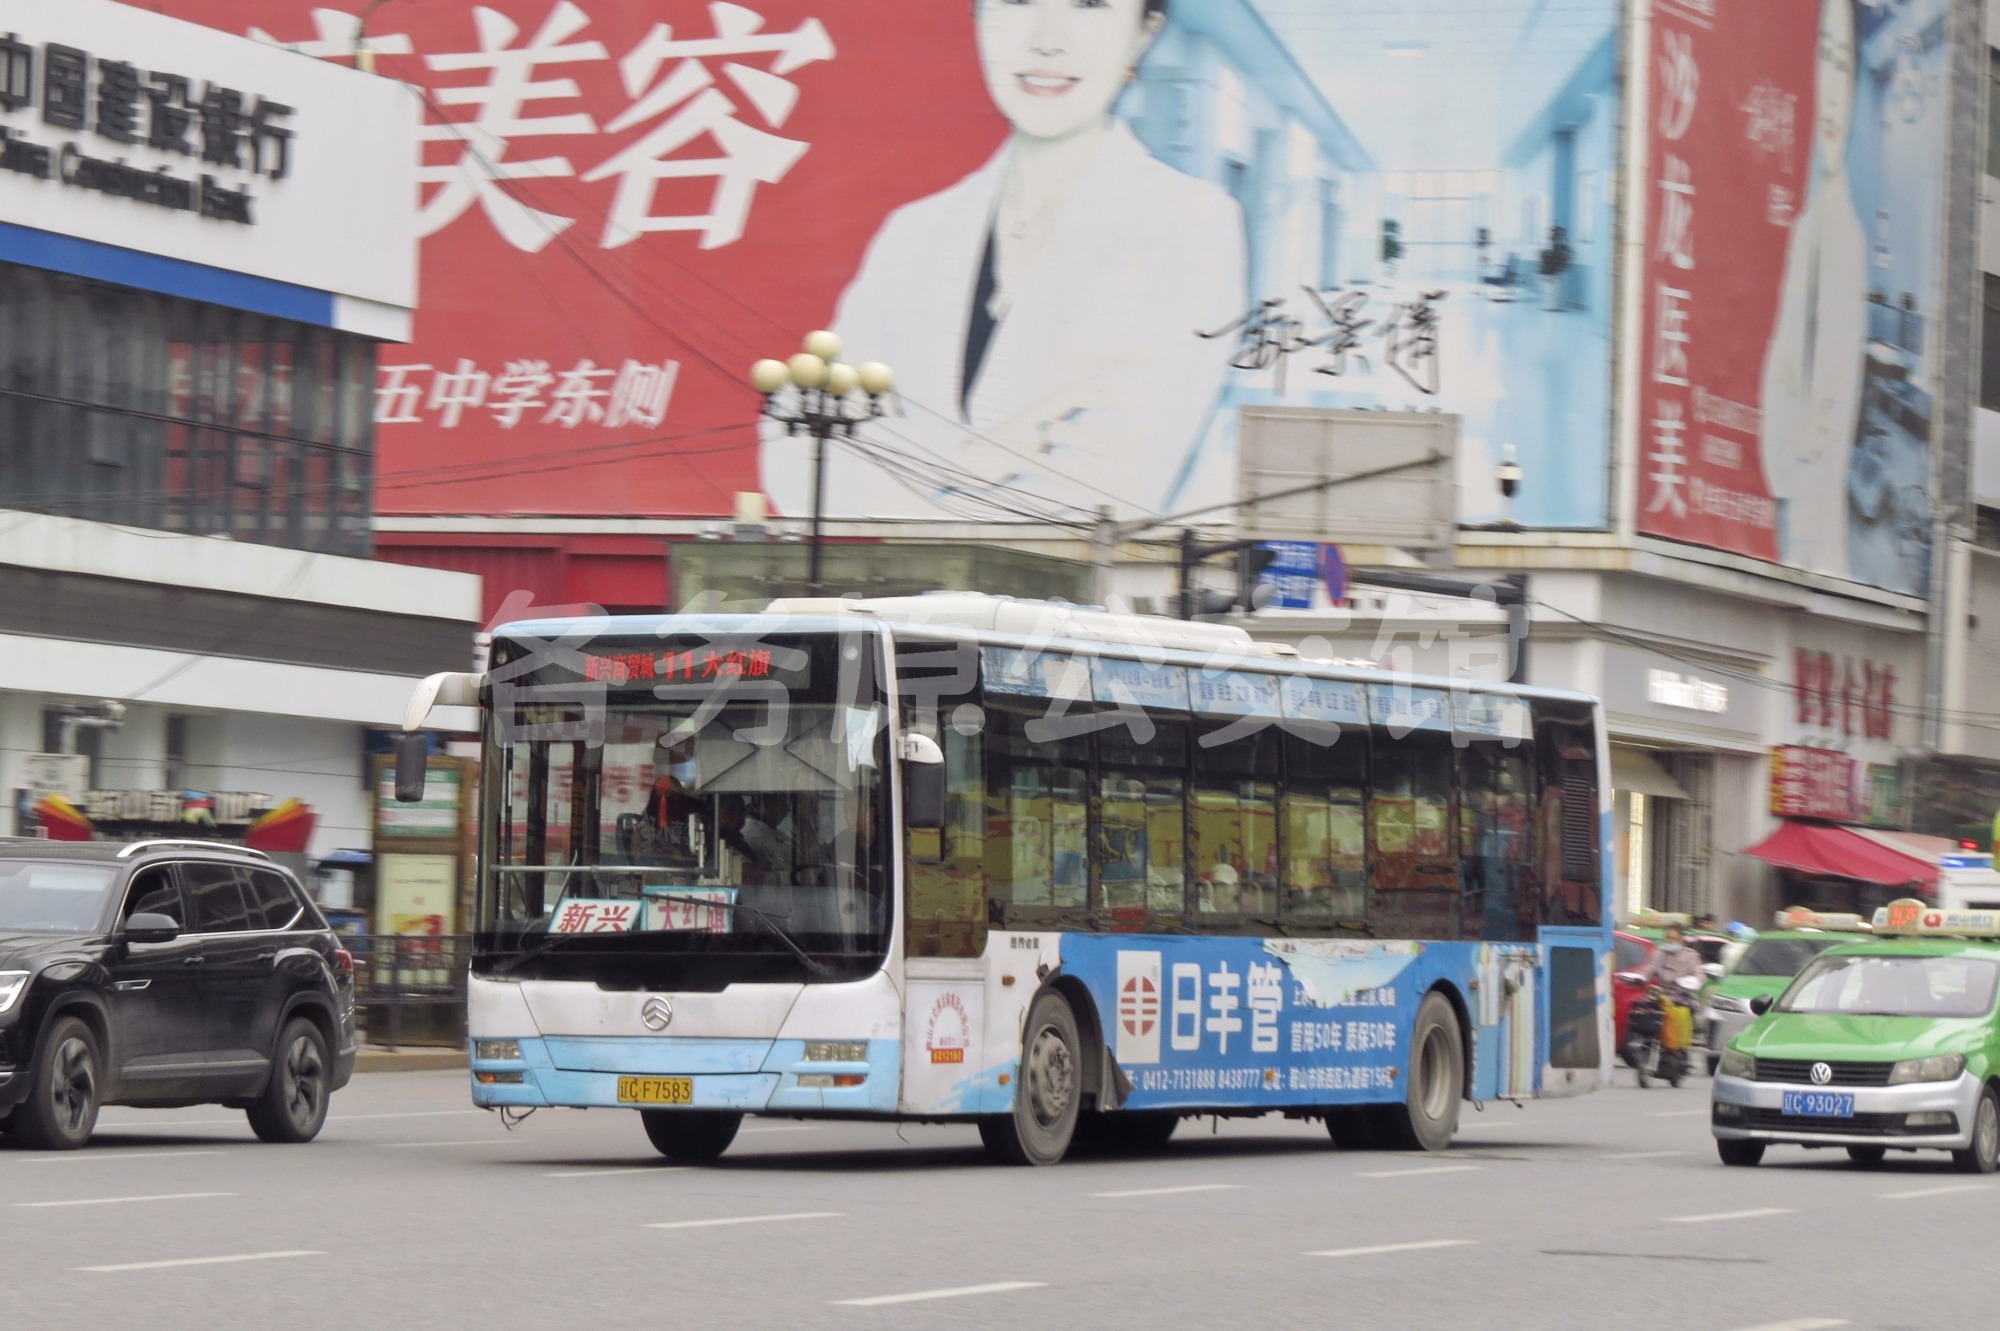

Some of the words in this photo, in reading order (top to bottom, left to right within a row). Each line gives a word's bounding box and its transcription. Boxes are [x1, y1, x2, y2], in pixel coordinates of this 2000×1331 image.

[0, 32, 297, 181] 中国建设银行
[247, 0, 837, 251] 美容
[373, 357, 681, 429] 五中学东侧
[585, 653, 655, 681] 新兴商贸城
[662, 650, 695, 679] 11
[702, 649, 772, 678] 大红旗
[558, 903, 630, 933] 新兴
[1171, 960, 1283, 1055] 日丰管
